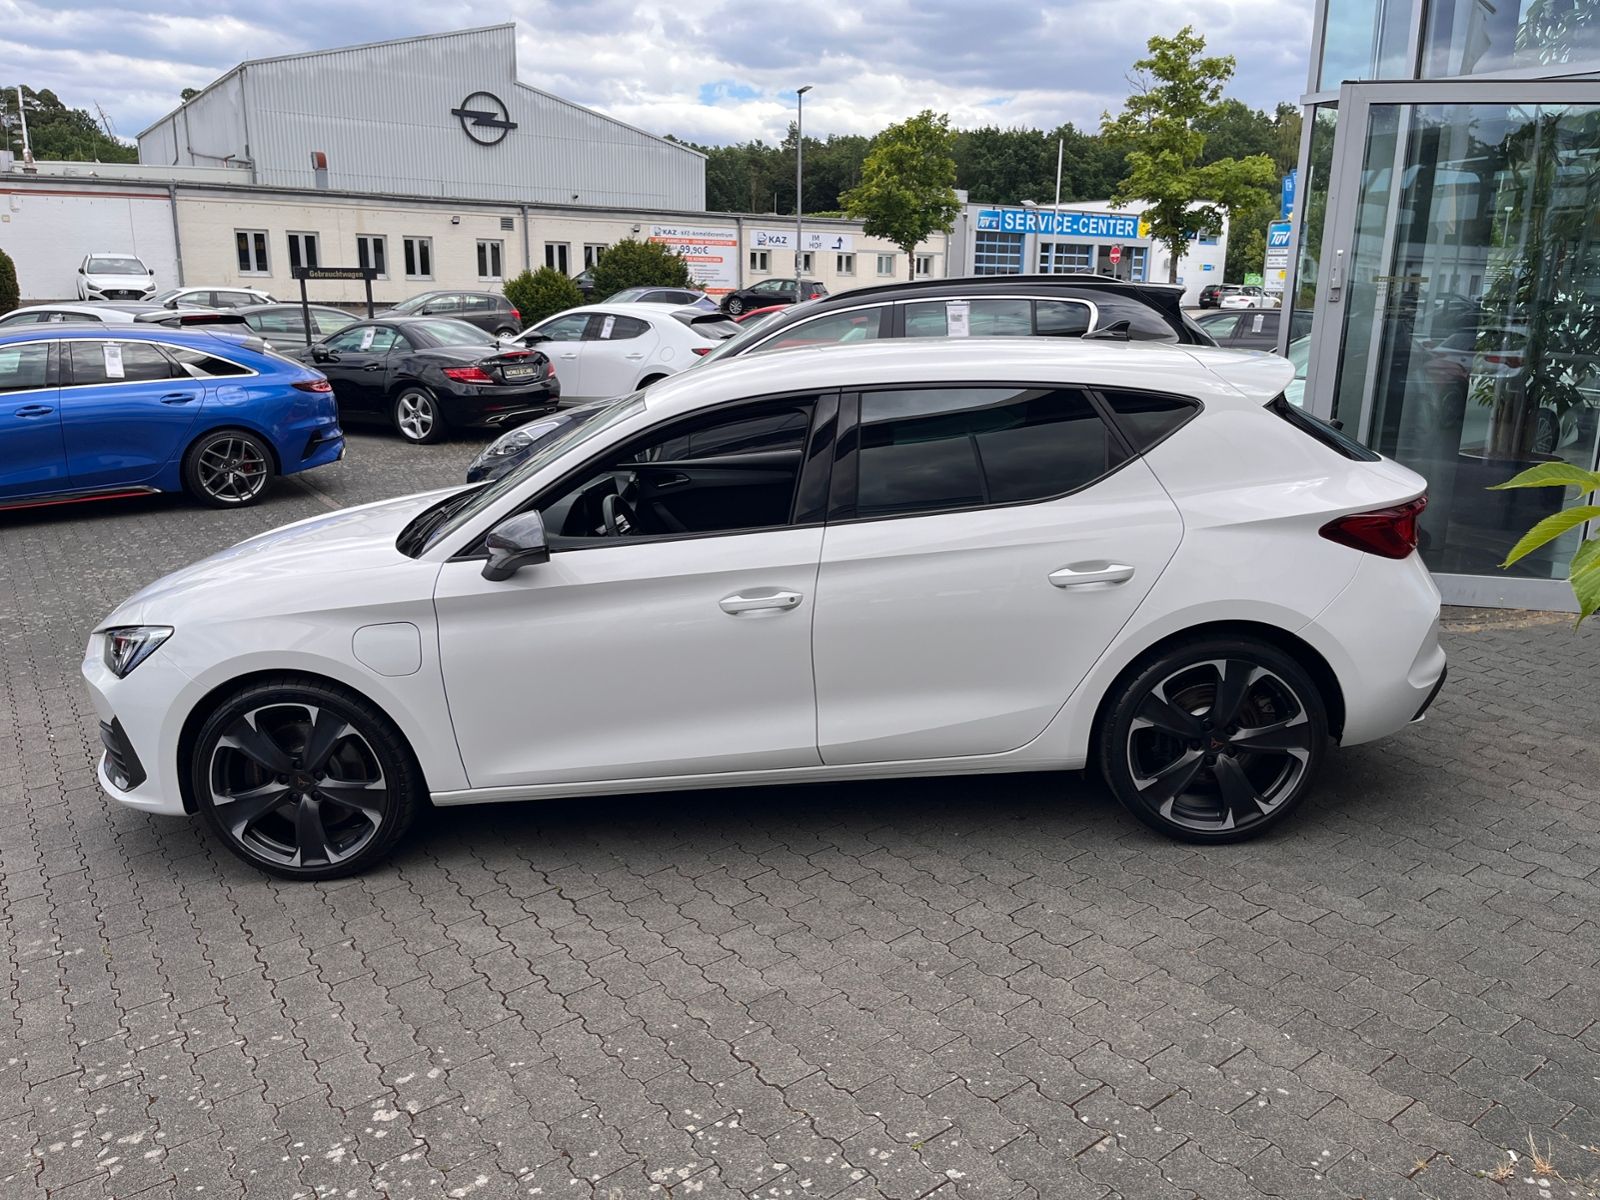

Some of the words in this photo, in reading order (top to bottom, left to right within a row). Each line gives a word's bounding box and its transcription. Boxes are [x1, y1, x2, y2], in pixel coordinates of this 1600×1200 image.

[1004, 212, 1134, 236] SERVICE-CENTER
[768, 236, 787, 244] KAZ
[808, 241, 822, 249] HOF
[309, 270, 364, 279] Gebrauchtwagen
